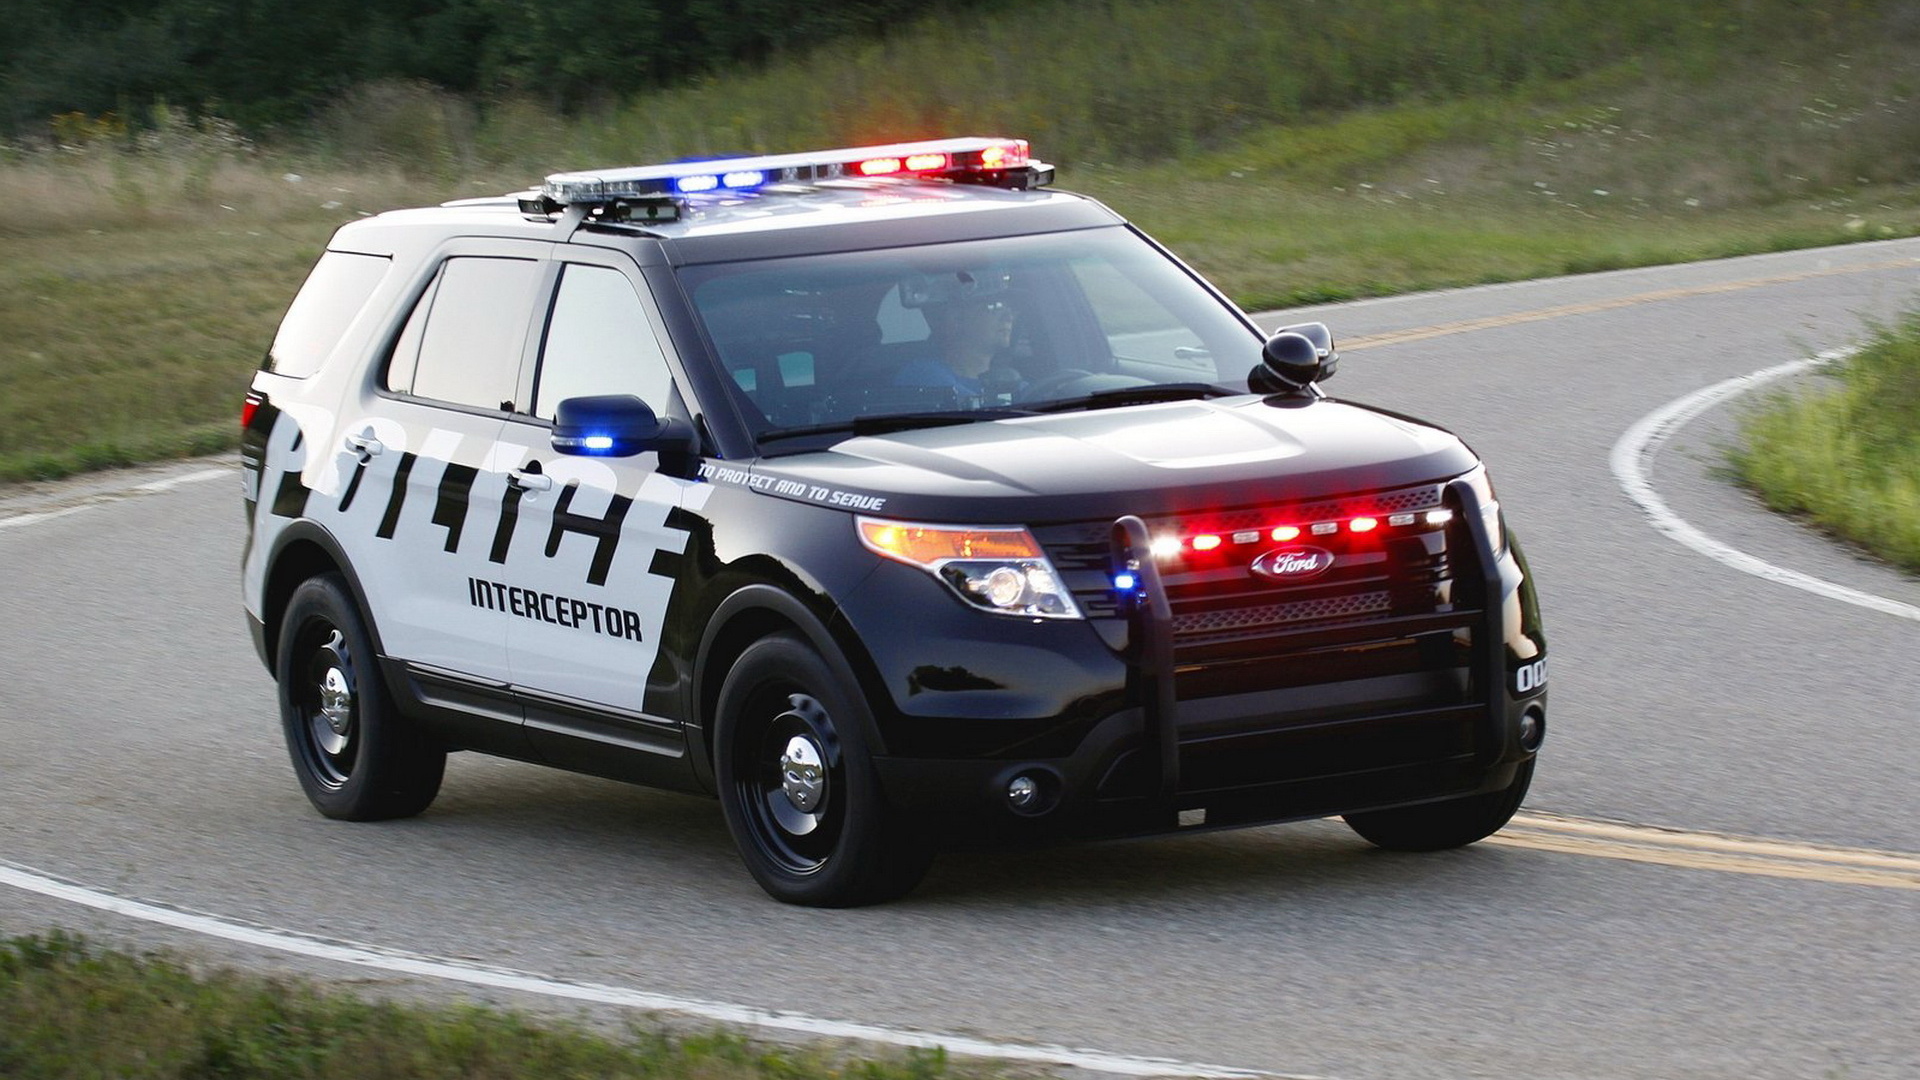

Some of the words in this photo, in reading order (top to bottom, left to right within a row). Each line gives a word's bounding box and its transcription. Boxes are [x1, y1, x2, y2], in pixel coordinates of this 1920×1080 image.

[256, 398, 715, 592] POLICE
[697, 463, 714, 478] TO
[715, 466, 776, 490] PROTECT
[774, 479, 806, 497] AND
[808, 485, 829, 501] TO
[829, 491, 887, 511] SERVE
[1273, 551, 1319, 574] Ford
[468, 576, 643, 643] INTERCEPTOR
